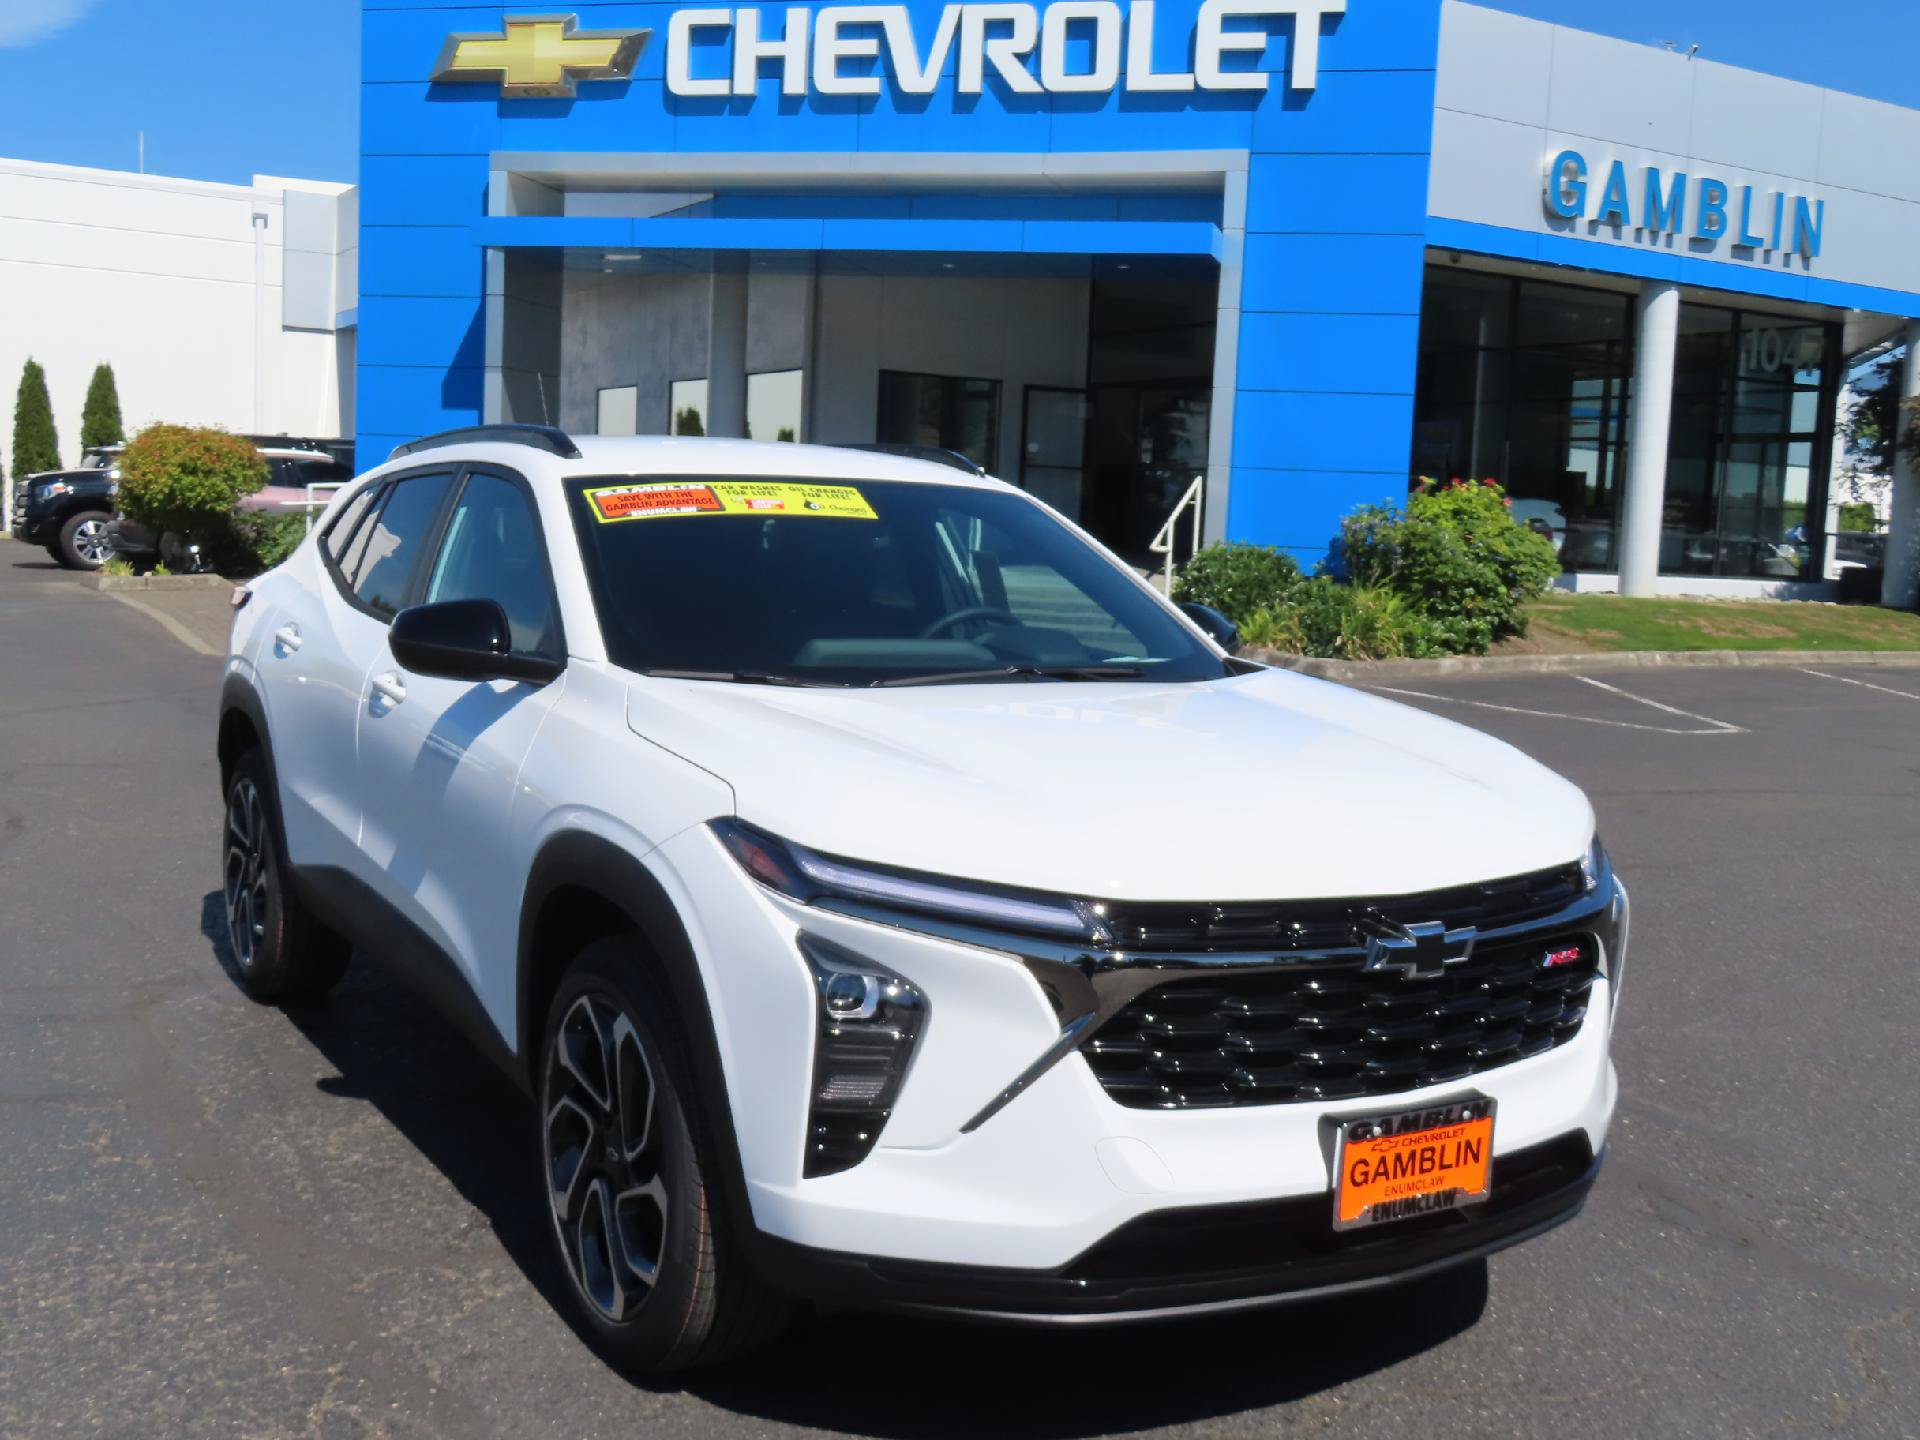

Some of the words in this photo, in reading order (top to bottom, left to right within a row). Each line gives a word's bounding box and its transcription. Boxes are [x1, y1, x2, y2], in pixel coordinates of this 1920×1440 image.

[666, 0, 1346, 96] CHEVROLET
[1546, 149, 1824, 258] GAMBLIN
[605, 501, 653, 512] GAMBLIN
[655, 497, 716, 508] ADVANTAGE
[617, 495, 643, 503] SAVE
[644, 492, 673, 500] WITH
[1401, 1127, 1467, 1148] CHEVROLET
[1350, 1137, 1482, 1188] GAMBLIN
[1385, 1175, 1446, 1197] ENUMCLAW
[1372, 1187, 1457, 1222] ENUMCLAW
